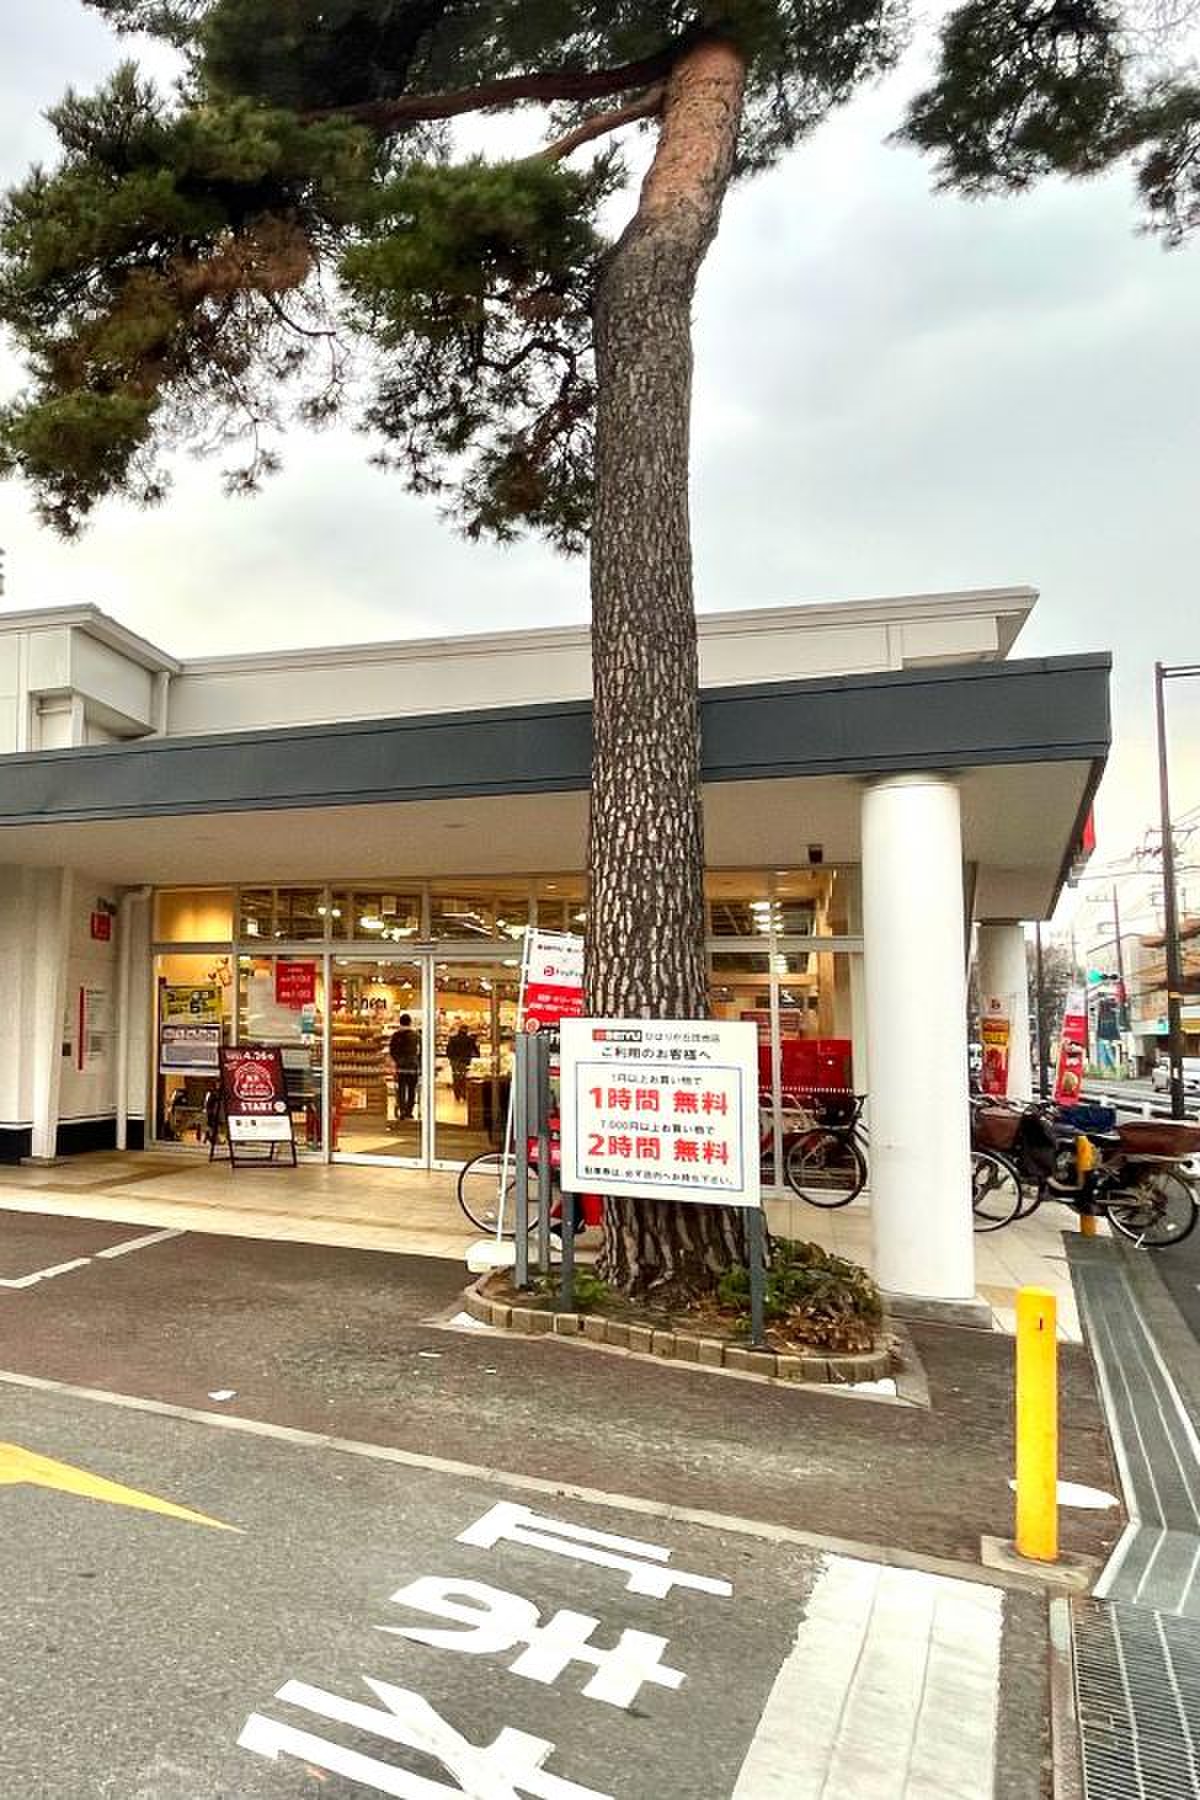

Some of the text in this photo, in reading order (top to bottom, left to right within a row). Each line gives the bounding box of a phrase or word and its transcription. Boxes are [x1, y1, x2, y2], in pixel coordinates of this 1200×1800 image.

[589, 1087, 728, 1115] 1時間 無料
[588, 1134, 661, 1160] 2時間
[673, 1138, 729, 1165] 無料
